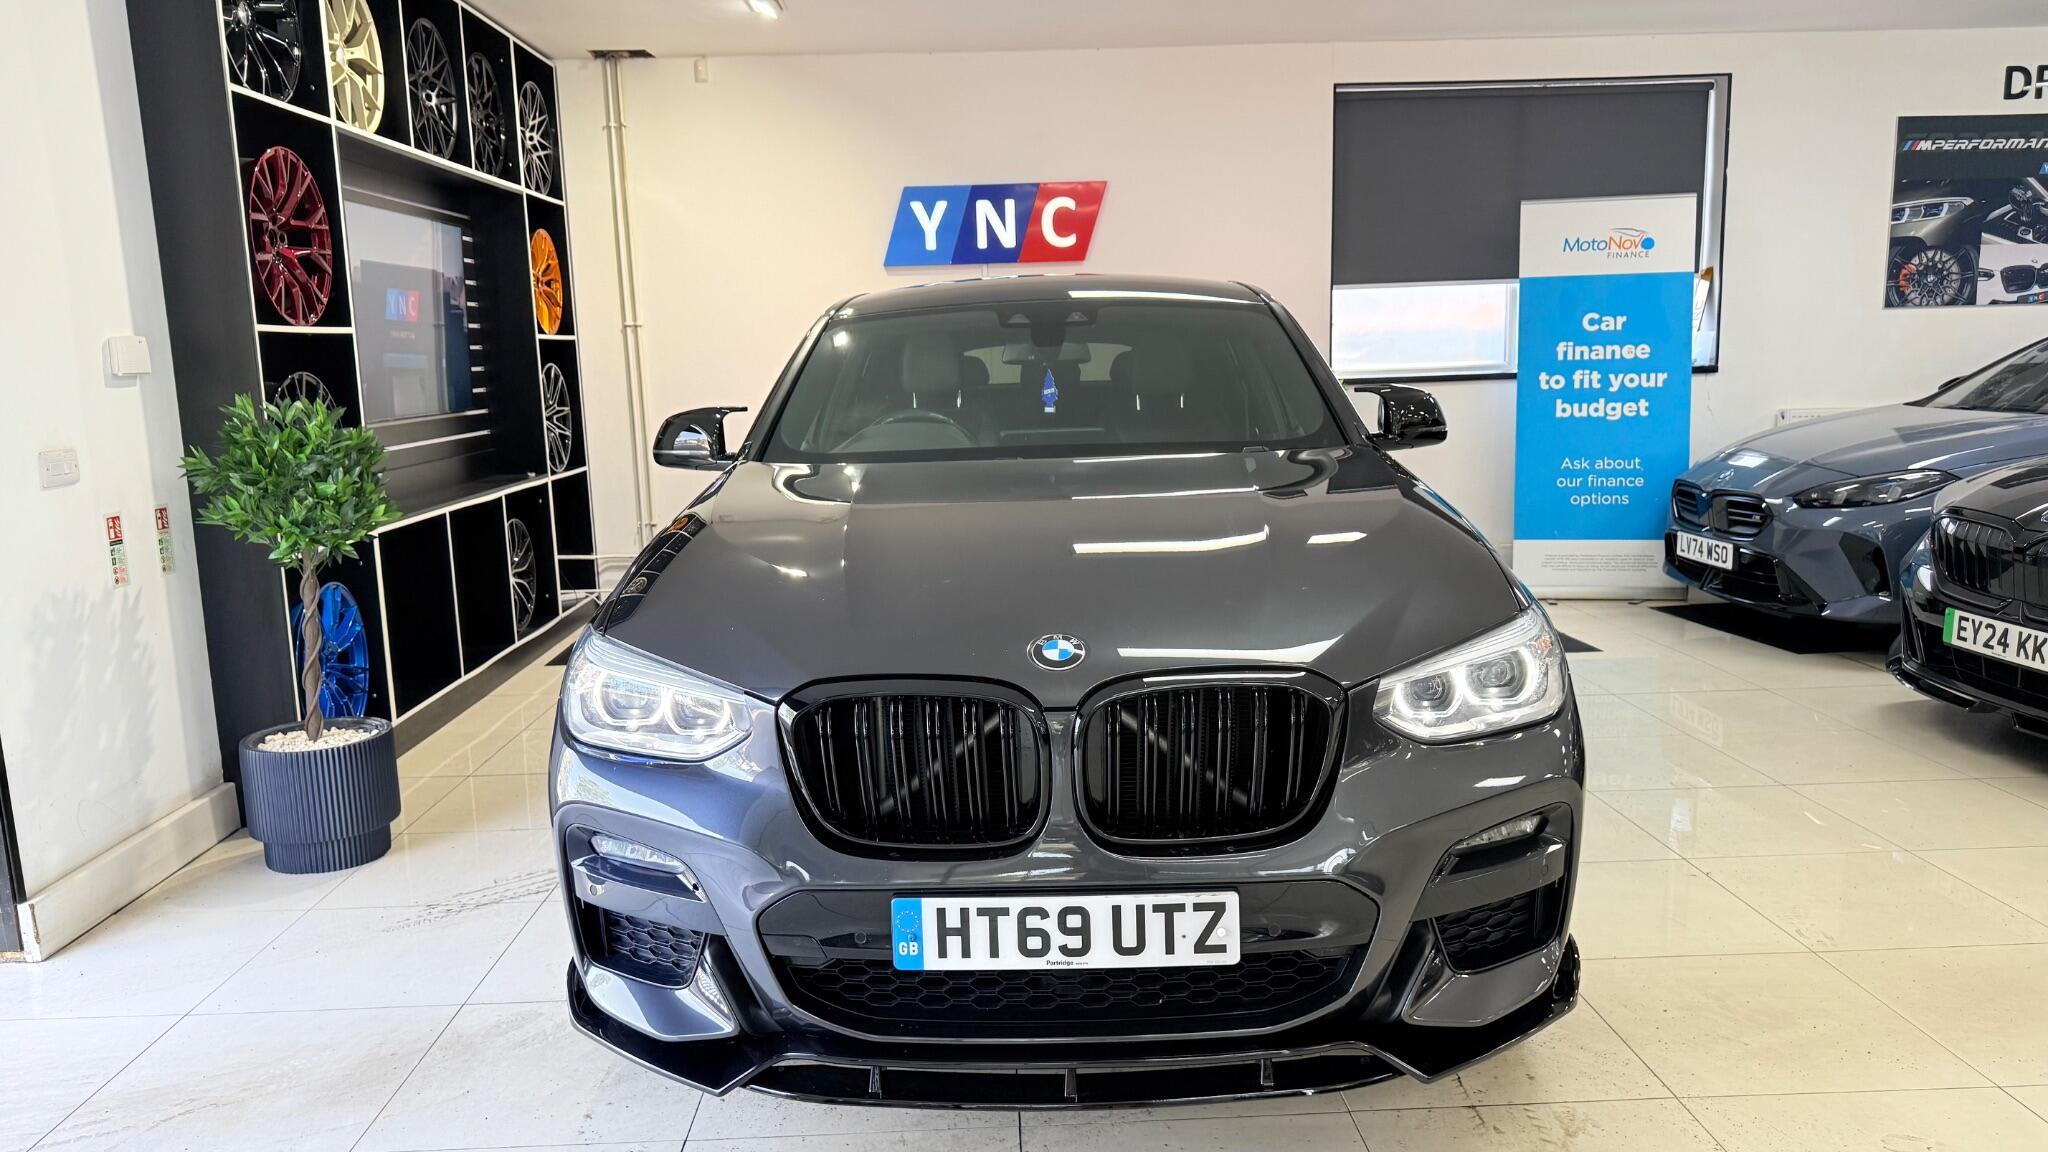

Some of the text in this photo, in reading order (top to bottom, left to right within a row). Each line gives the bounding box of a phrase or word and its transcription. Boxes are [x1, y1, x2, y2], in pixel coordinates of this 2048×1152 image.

[909, 196, 1077, 251] YNC
[1607, 250, 1649, 258] FINANCE
[1582, 312, 1627, 331] Car
[1556, 342, 1651, 360] finance
[1539, 370, 1668, 393] to fit your
[1555, 398, 1649, 420] budget
[1561, 456, 1641, 469] Ask about
[1556, 474, 1644, 488] our finance
[1570, 492, 1630, 507] options
[1680, 534, 1704, 558] LV74
[1956, 615, 2048, 665] EY24 KK
[936, 901, 1228, 959] HT69 UTZ
[898, 941, 919, 956] GB
